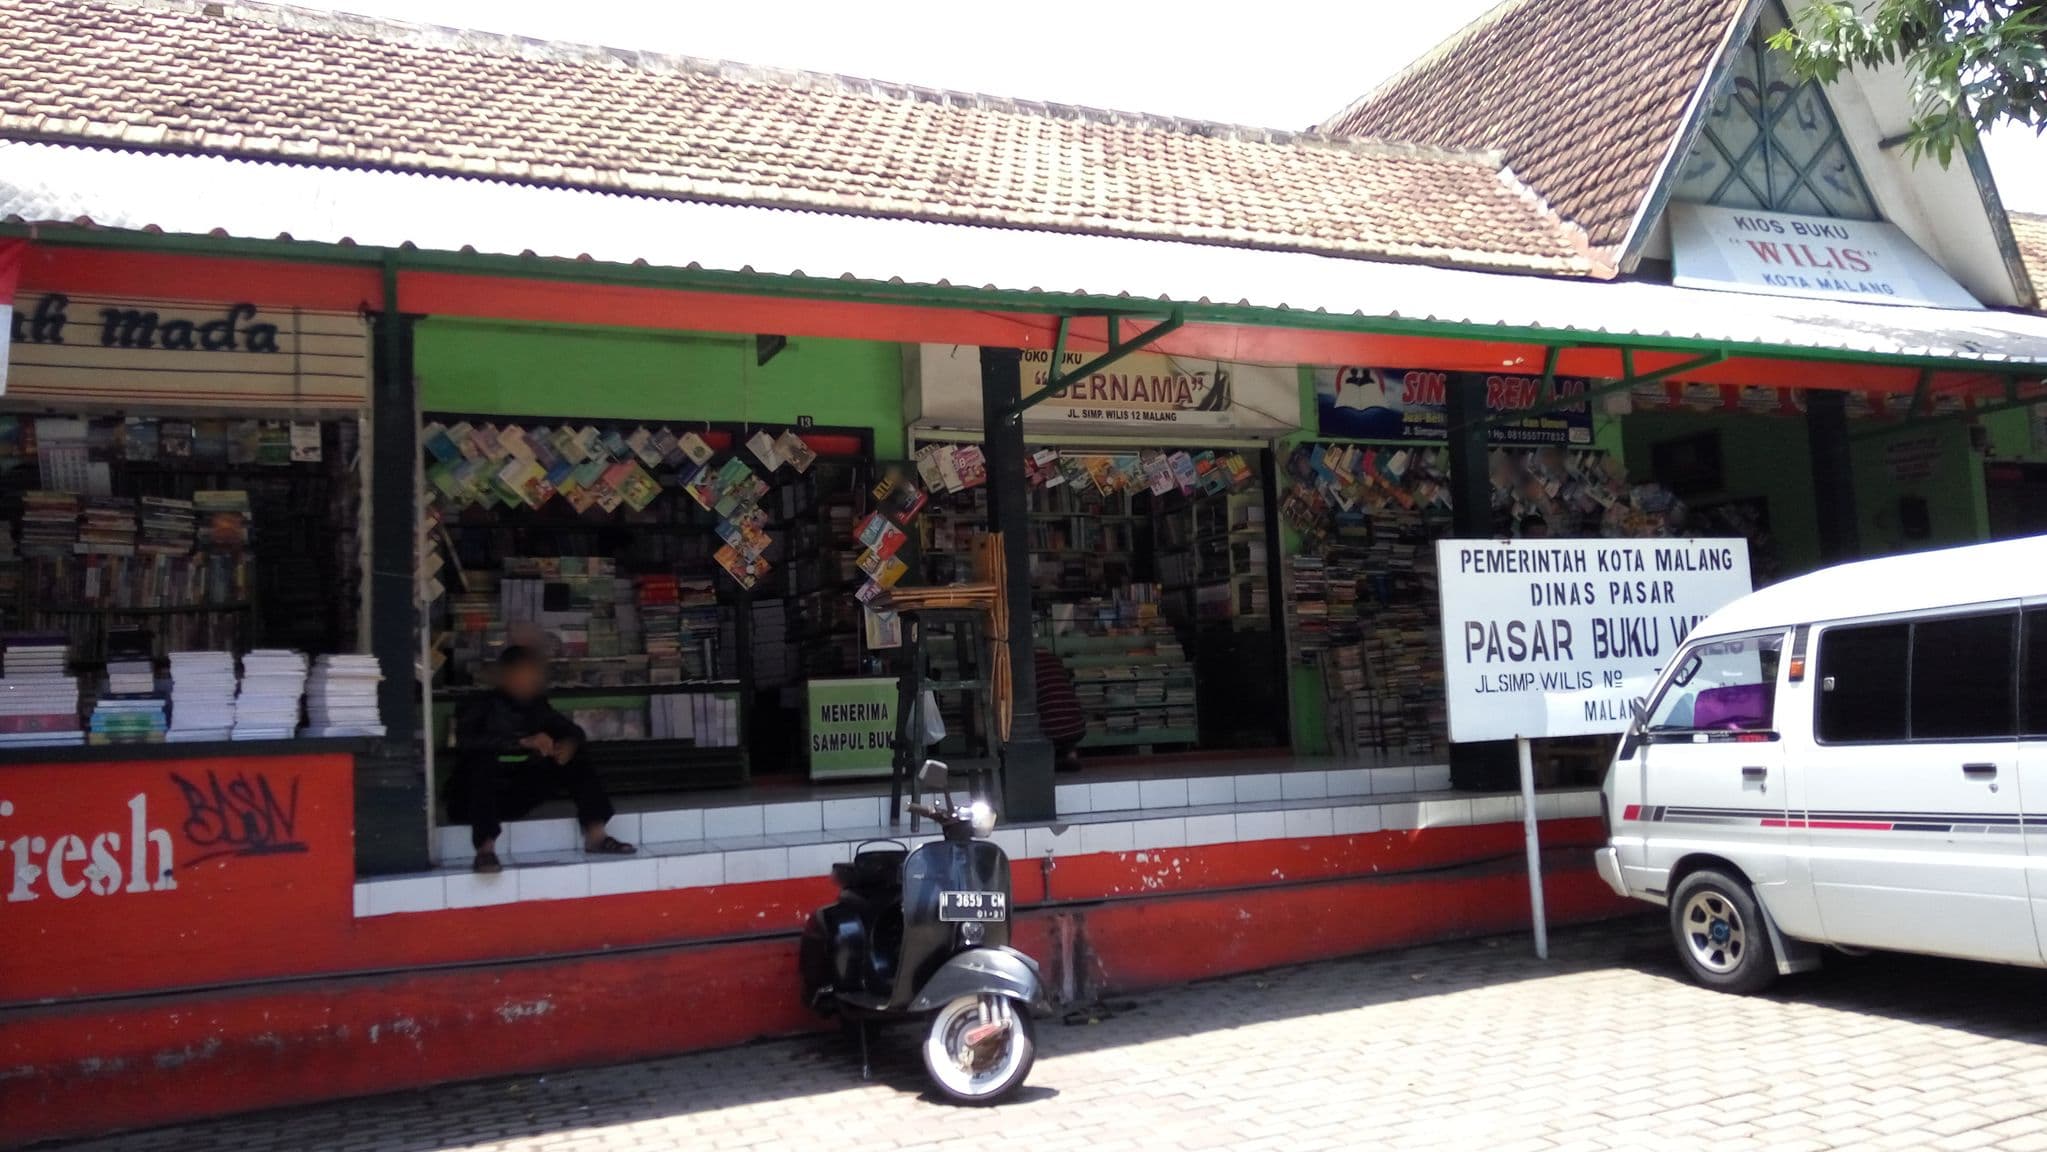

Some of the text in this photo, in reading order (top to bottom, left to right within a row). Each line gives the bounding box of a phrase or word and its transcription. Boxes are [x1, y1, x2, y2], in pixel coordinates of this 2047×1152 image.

[1733, 216, 1850, 240] KIOS BUKU
[1763, 273, 1895, 296] KOTA MALANG
[100, 303, 280, 354] mada
[1018, 350, 1049, 363] TOKO
[1106, 410, 1129, 421] WILIS
[1131, 411, 1141, 421] 12
[1142, 411, 1177, 422] MALANG
[1460, 548, 1734, 573] PEMERINTAH KOTA MALANG
[1531, 580, 1676, 607] DINAS PASAR
[1464, 618, 1574, 664] PASAR
[1591, 616, 1660, 660] BUKU
[821, 704, 889, 722] MENERIMA
[1584, 698, 1637, 722] MALAN
[812, 732, 865, 752] SAMPUL
[0, 792, 178, 904] resh
